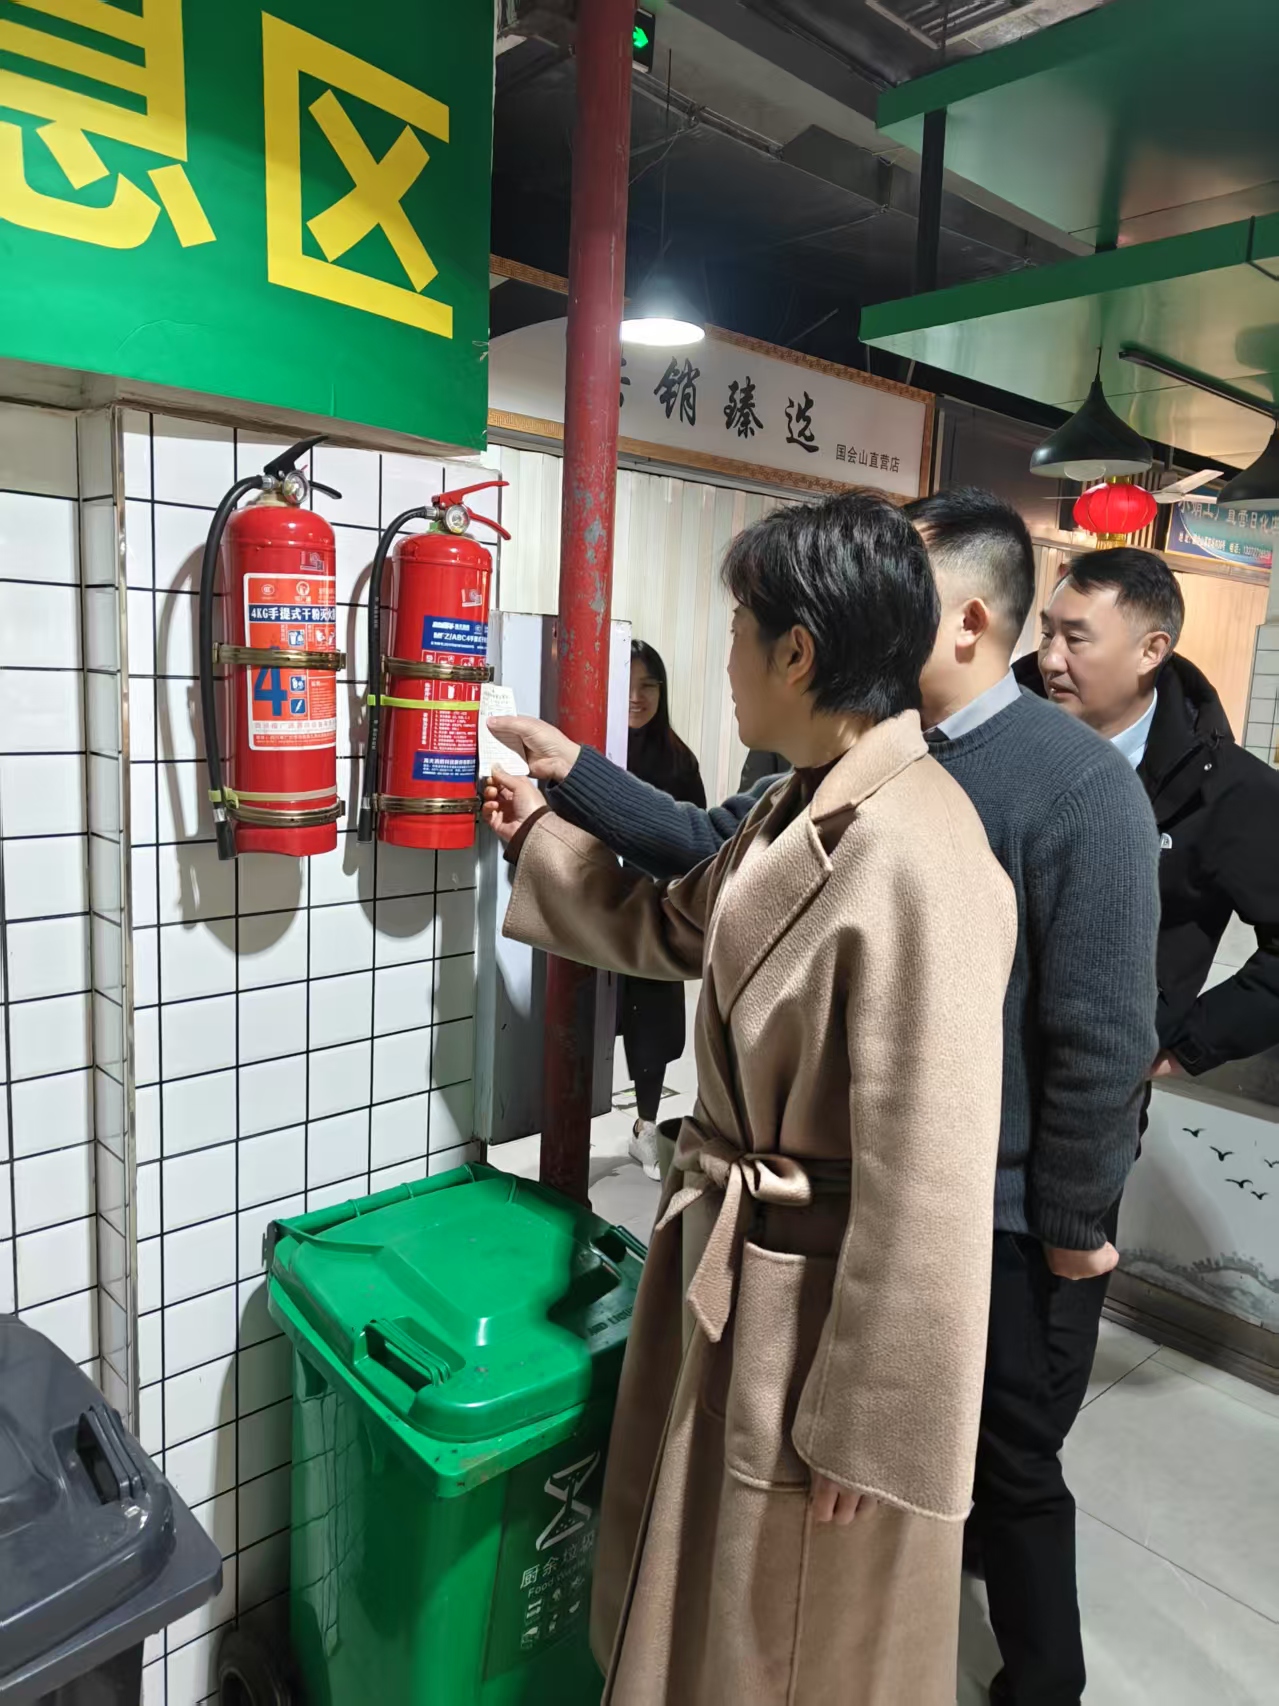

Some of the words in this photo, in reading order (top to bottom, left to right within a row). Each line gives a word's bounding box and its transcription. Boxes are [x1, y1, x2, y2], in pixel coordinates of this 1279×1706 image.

[835, 443, 901, 474] 国会山直营店
[254, 646, 288, 716] 4
[520, 1529, 595, 1589] 厨余垃圾
[527, 1577, 554, 1599] Food
